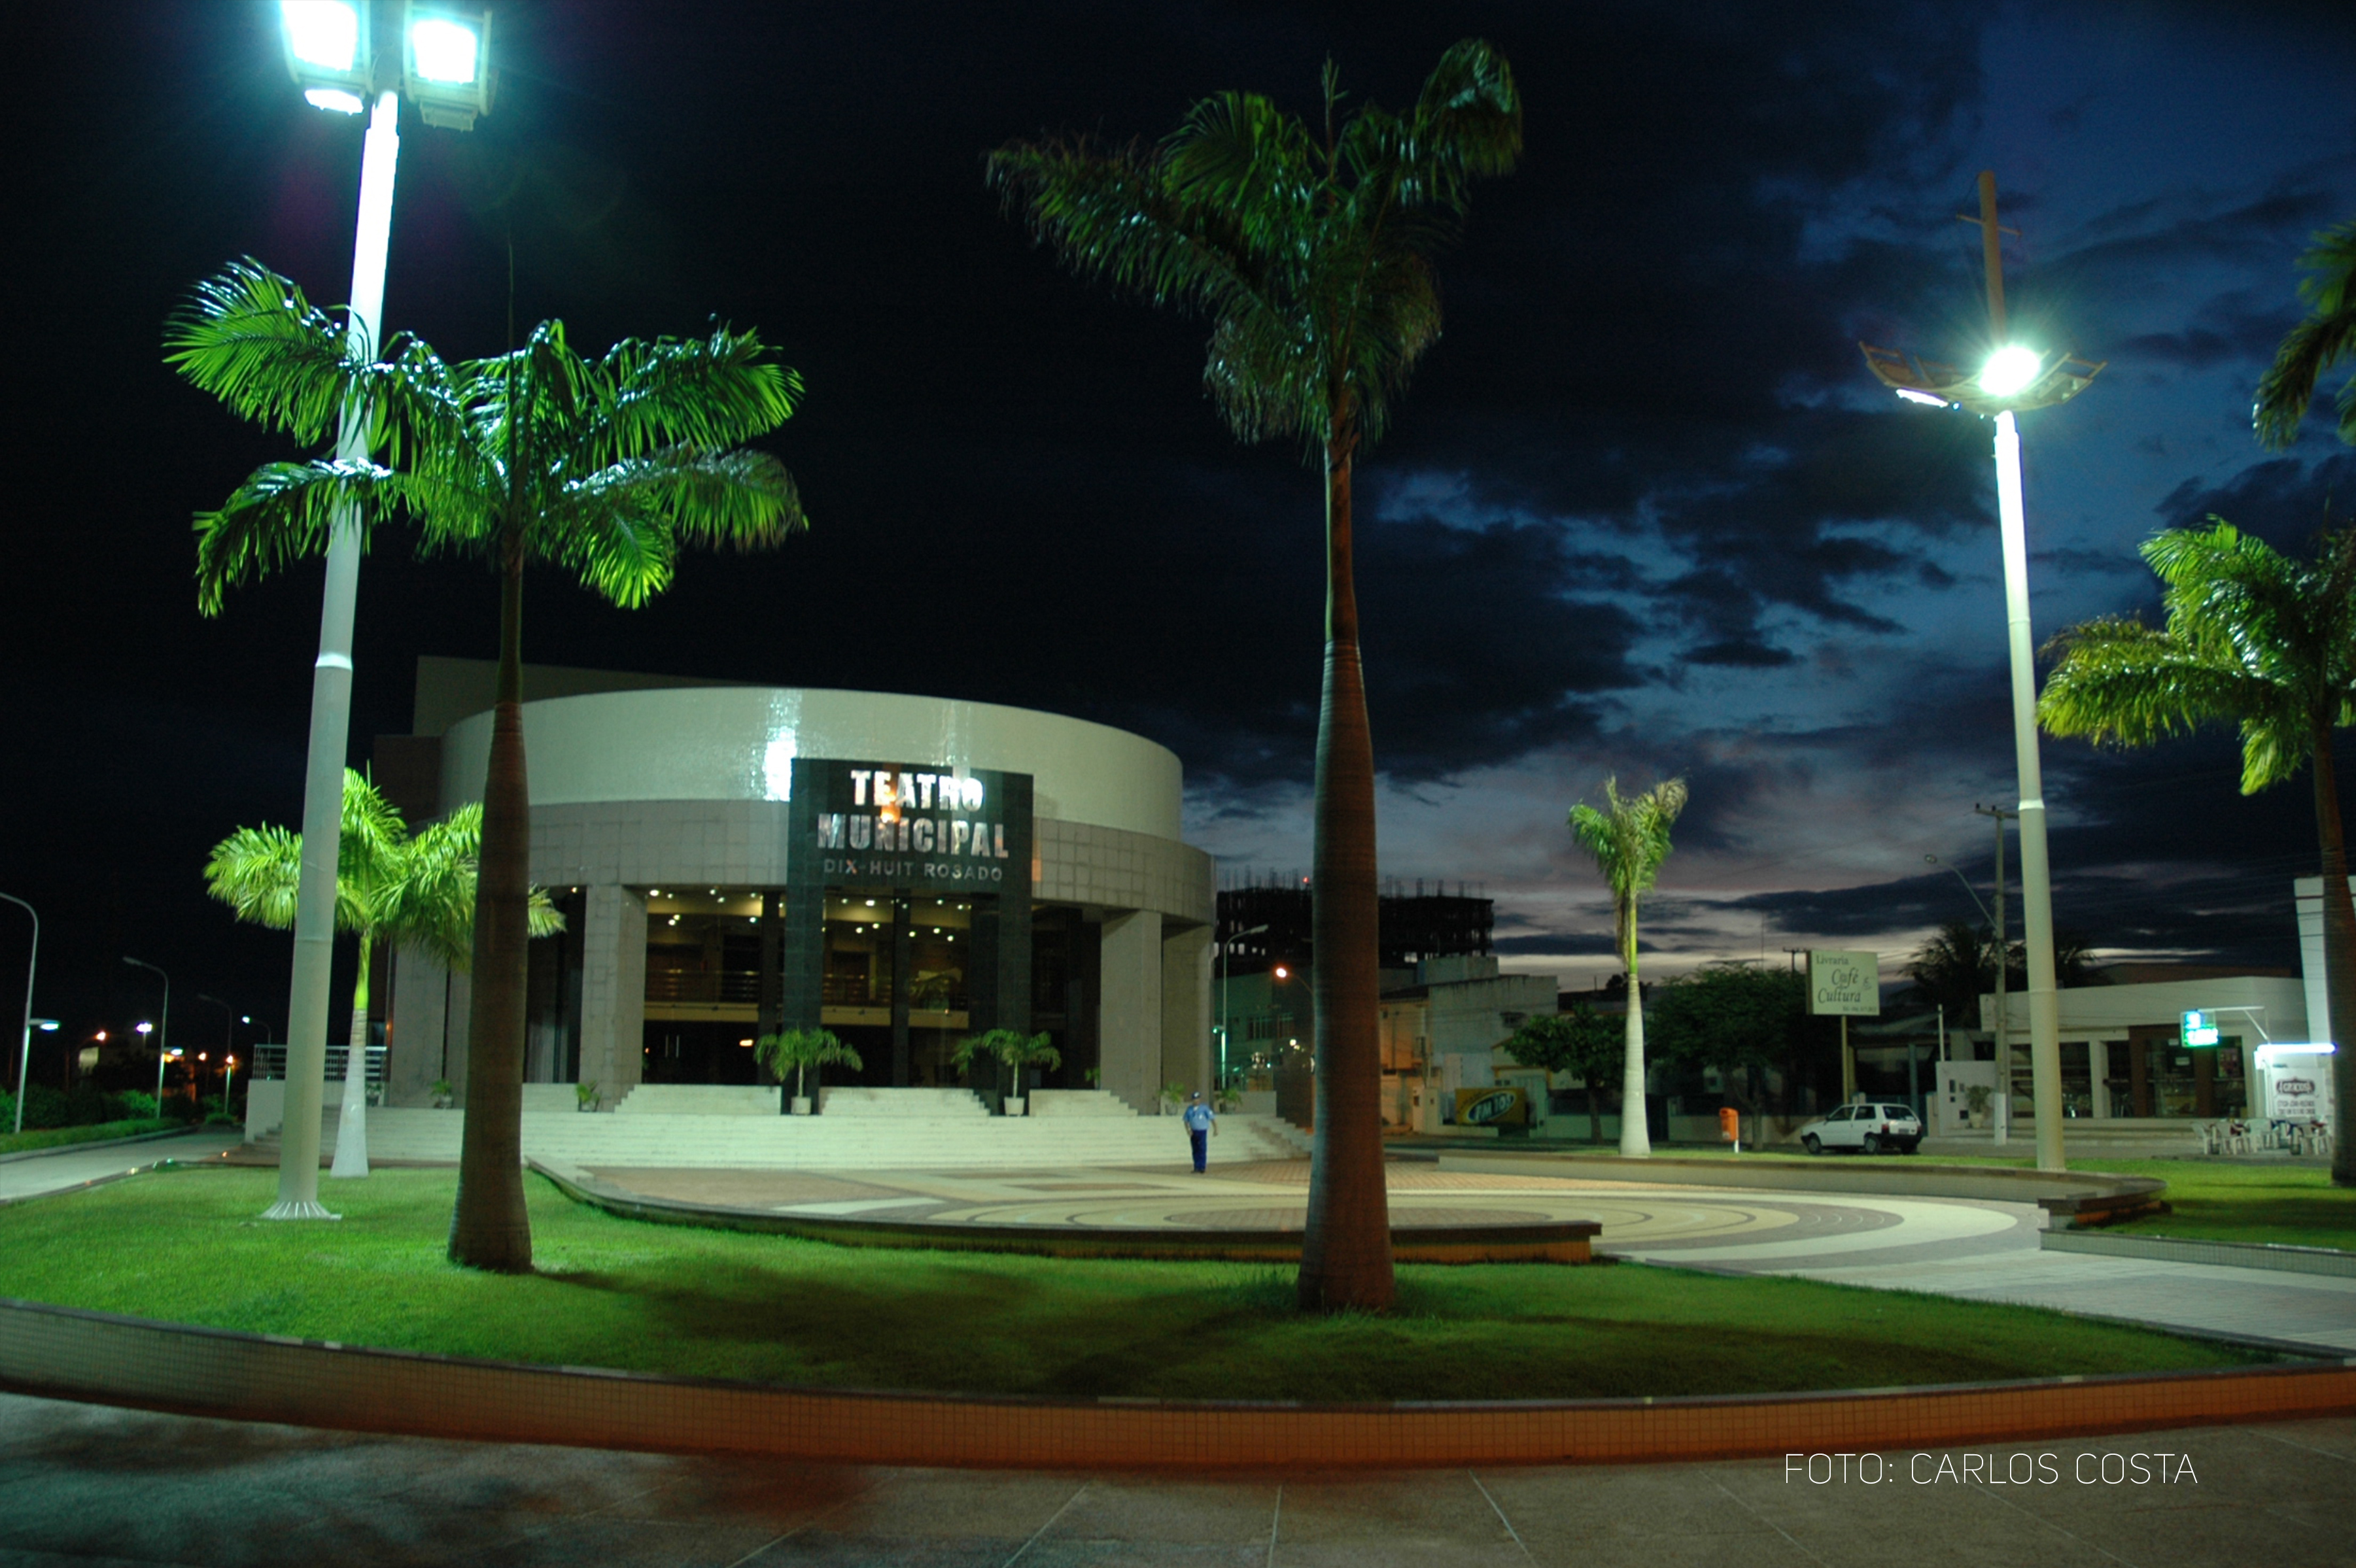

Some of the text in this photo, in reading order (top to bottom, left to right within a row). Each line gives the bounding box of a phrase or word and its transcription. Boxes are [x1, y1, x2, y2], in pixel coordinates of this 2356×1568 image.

[850, 770, 984, 811] TEATRO
[818, 813, 1009, 859] MUNICIPAL
[824, 859, 1003, 882] DIX-HUIT ROSADO
[1816, 955, 1849, 965] Livraria
[1832, 967, 1859, 989] Café
[1818, 986, 1862, 1004] Cultura
